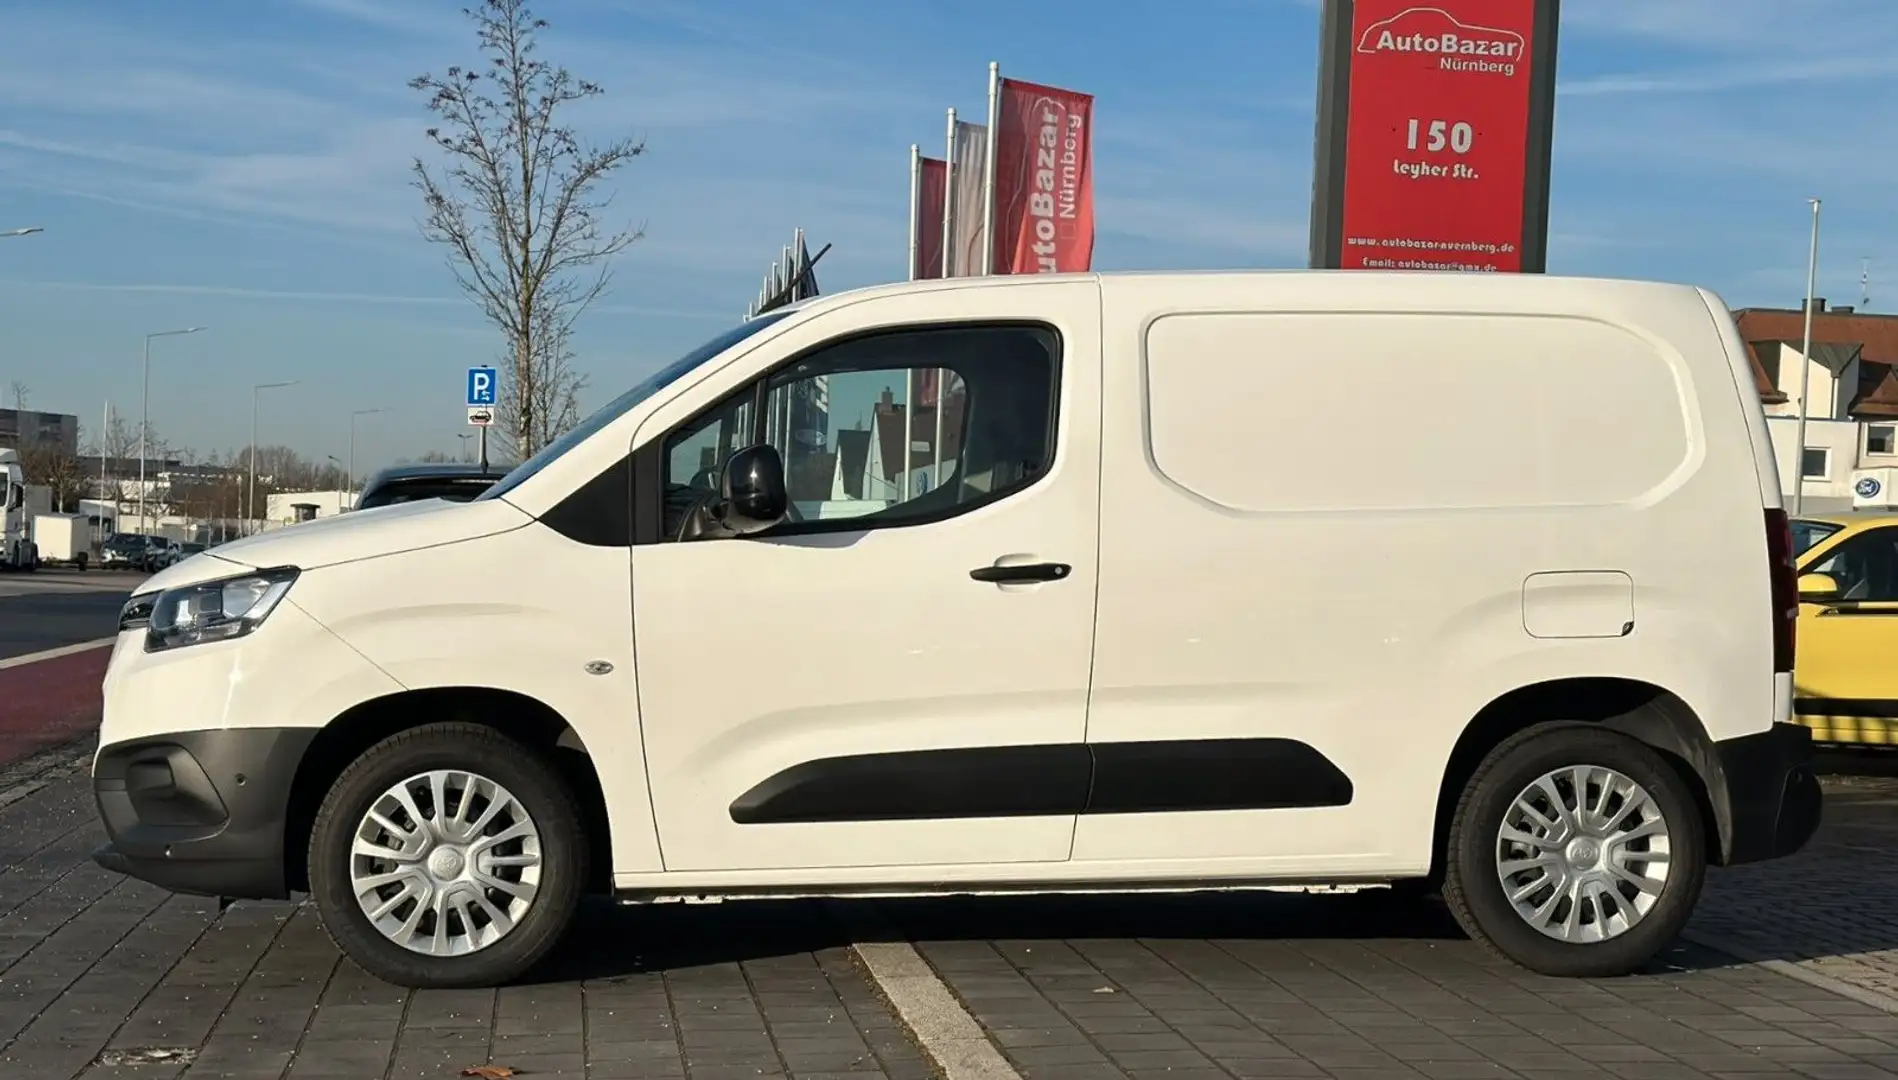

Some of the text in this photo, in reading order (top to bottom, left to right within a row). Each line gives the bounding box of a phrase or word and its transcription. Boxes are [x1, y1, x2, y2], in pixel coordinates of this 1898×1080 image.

[1376, 30, 1518, 57] AutoBazar
[1440, 57, 1514, 76] Nürnberg
[1407, 119, 1472, 153] 150
[1059, 113, 1083, 218] Nürnberg
[1393, 159, 1479, 179] Leyher Str.
[1031, 106, 1059, 273] utoBazar
[474, 372, 490, 400] P
